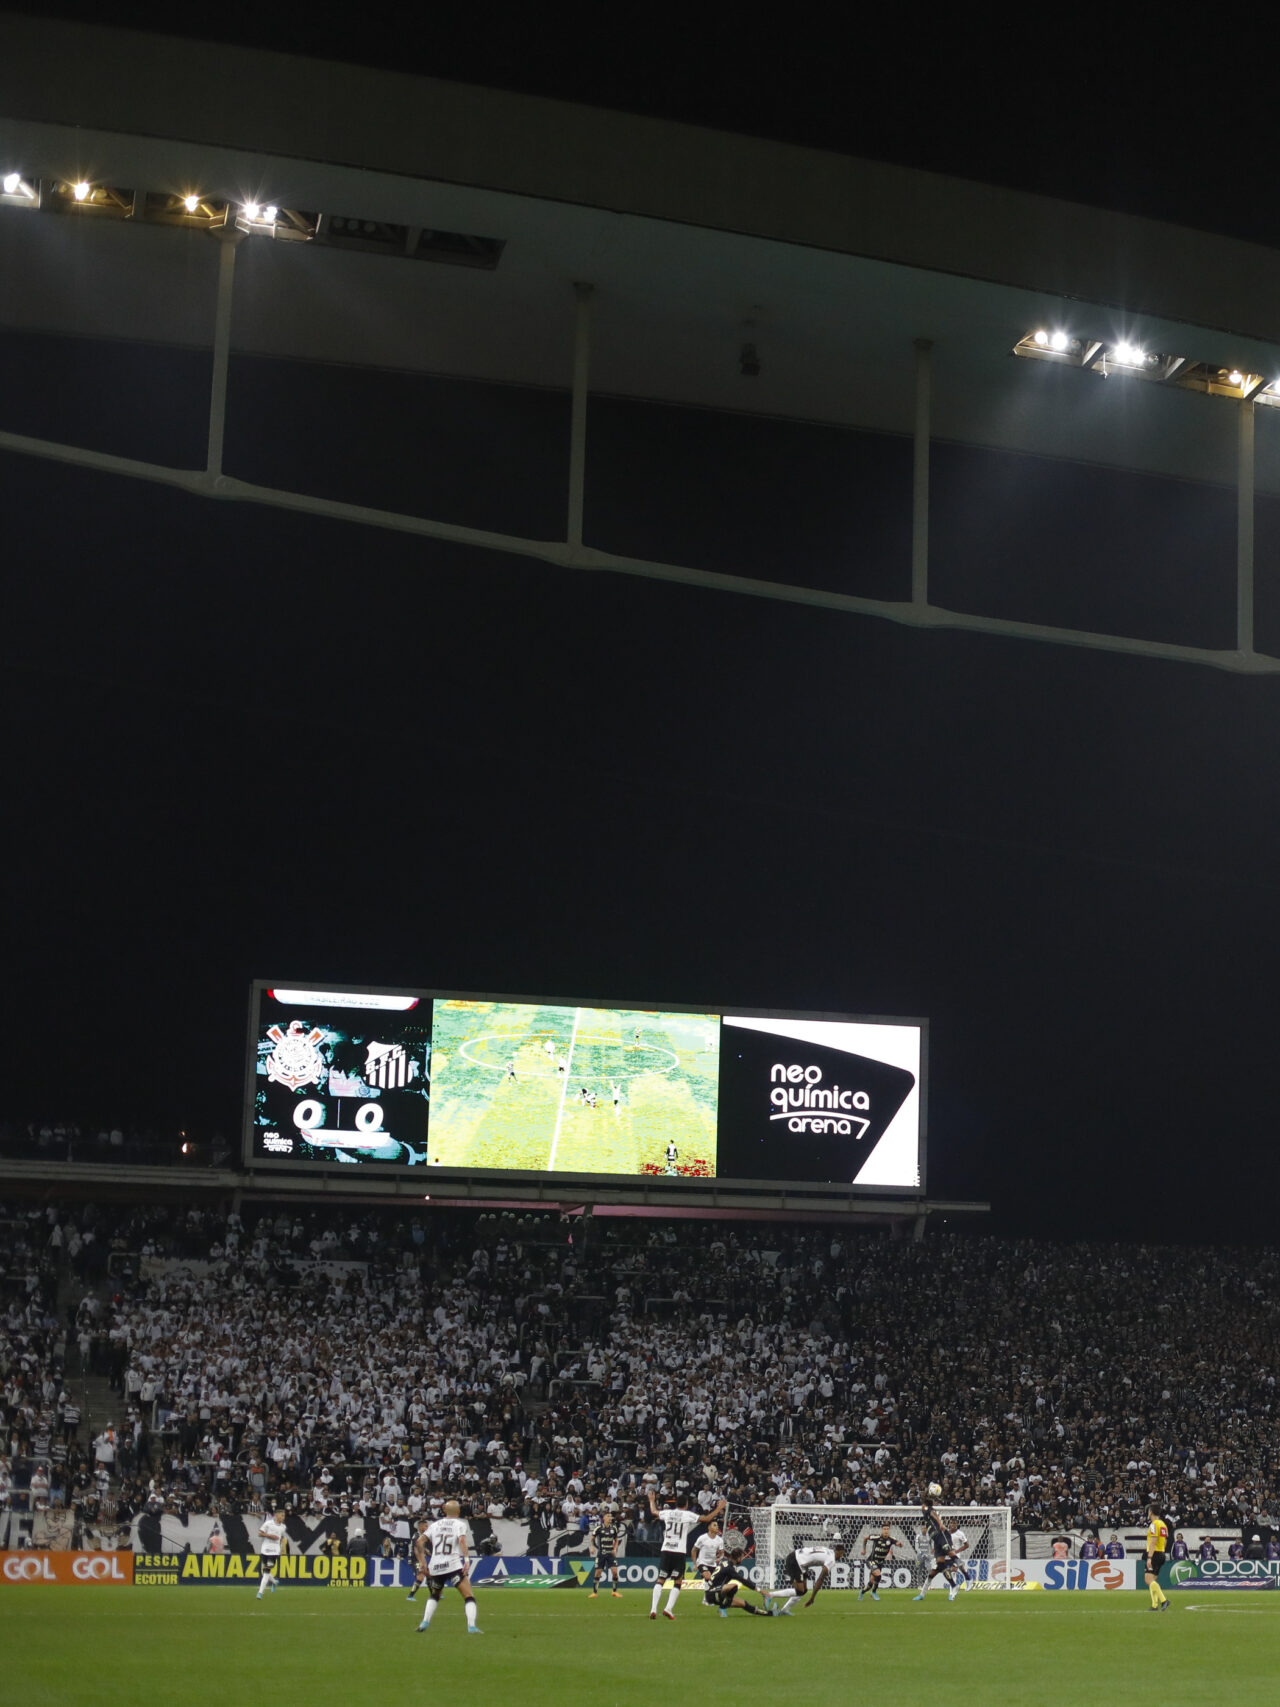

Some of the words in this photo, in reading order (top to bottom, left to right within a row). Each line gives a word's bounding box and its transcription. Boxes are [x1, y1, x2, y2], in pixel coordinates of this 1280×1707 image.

[770, 1064, 822, 1084] neo
[770, 1084, 870, 1112] química
[293, 1099, 323, 1129] 0
[355, 1102, 384, 1132] 0
[788, 1117, 851, 1135] arena
[665, 1521, 684, 1540] 24
[434, 1534, 452, 1556] 26
[3, 1557, 56, 1580] GOL
[72, 1556, 124, 1580] GOL
[135, 1555, 179, 1567] PESCA
[135, 1573, 178, 1585] ECOTUR
[1044, 1560, 1088, 1590] Sil
